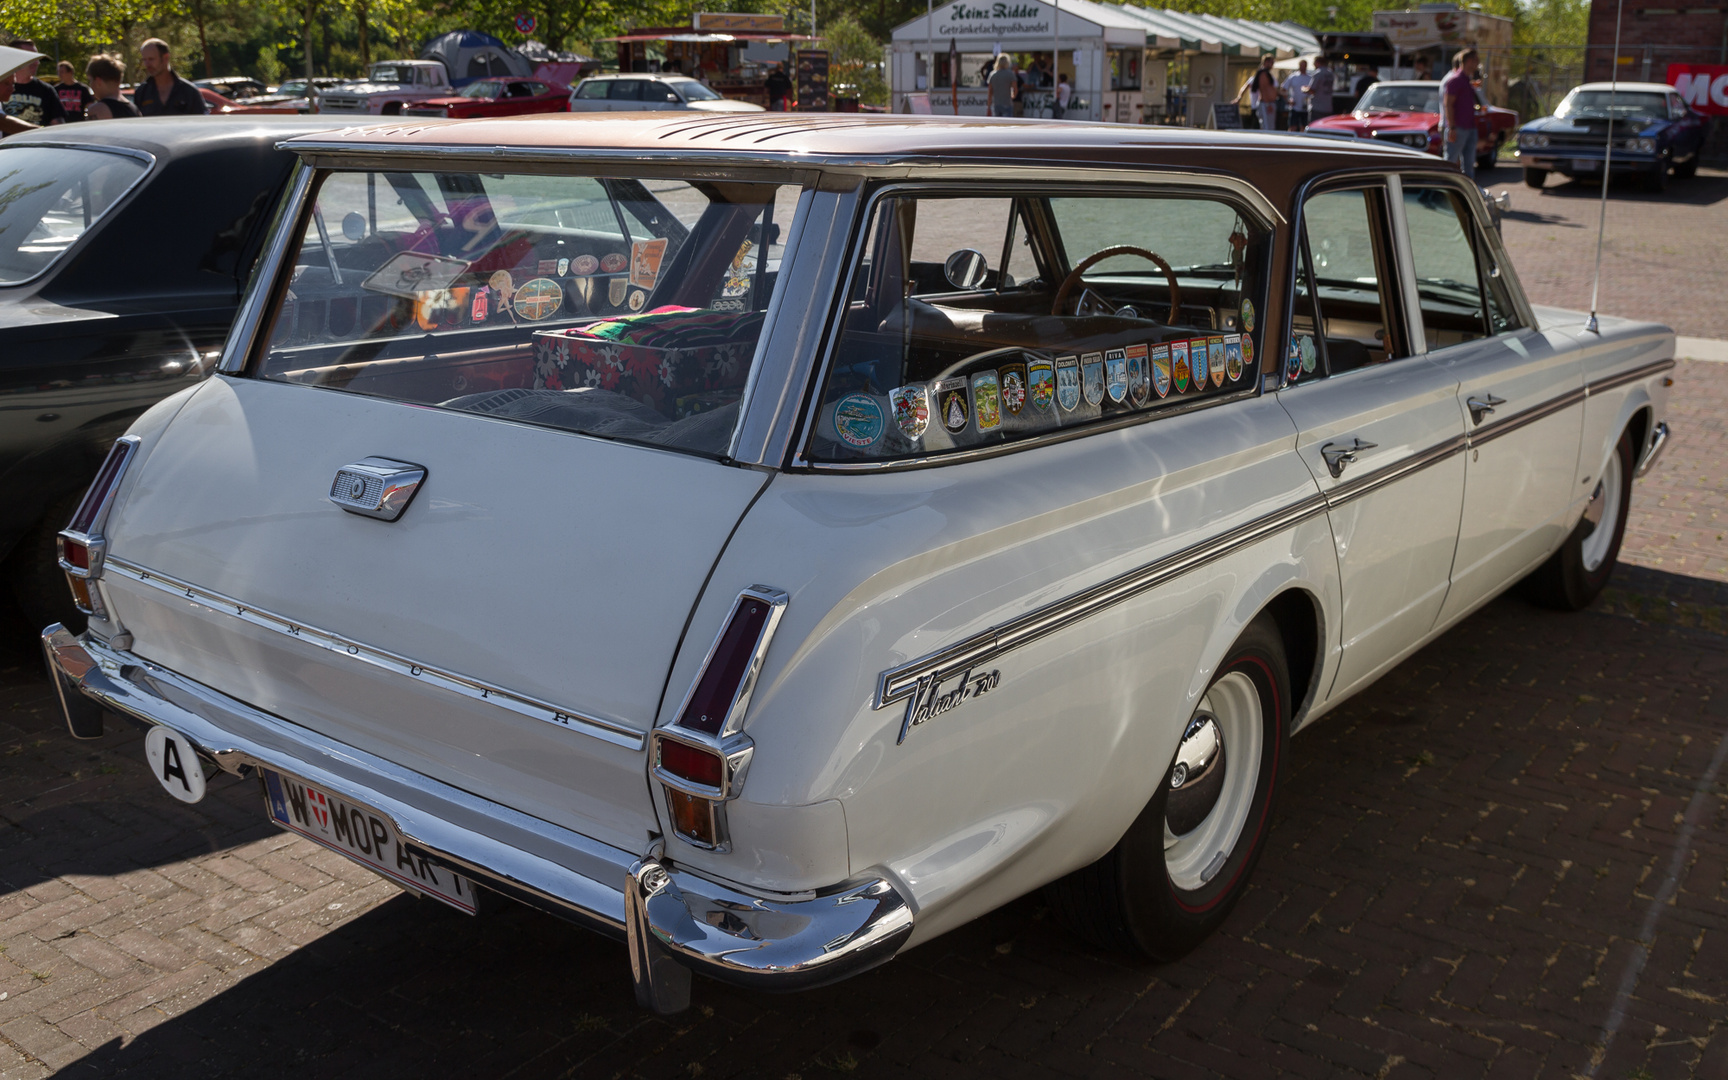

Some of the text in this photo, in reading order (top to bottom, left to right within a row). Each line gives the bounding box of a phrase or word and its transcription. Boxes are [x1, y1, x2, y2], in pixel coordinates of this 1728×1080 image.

[939, 21, 1049, 35] Getränkefachgroßhandel
[951, 2, 1040, 21] Heinz Ridder
[1108, 352, 1122, 360] RIVA
[843, 432, 872, 446] VIESTE
[138, 571, 571, 726] PLYMOUTH
[903, 667, 976, 730] Valiant
[163, 736, 192, 793] A
[276, 799, 286, 816] A
[284, 776, 310, 827] W
